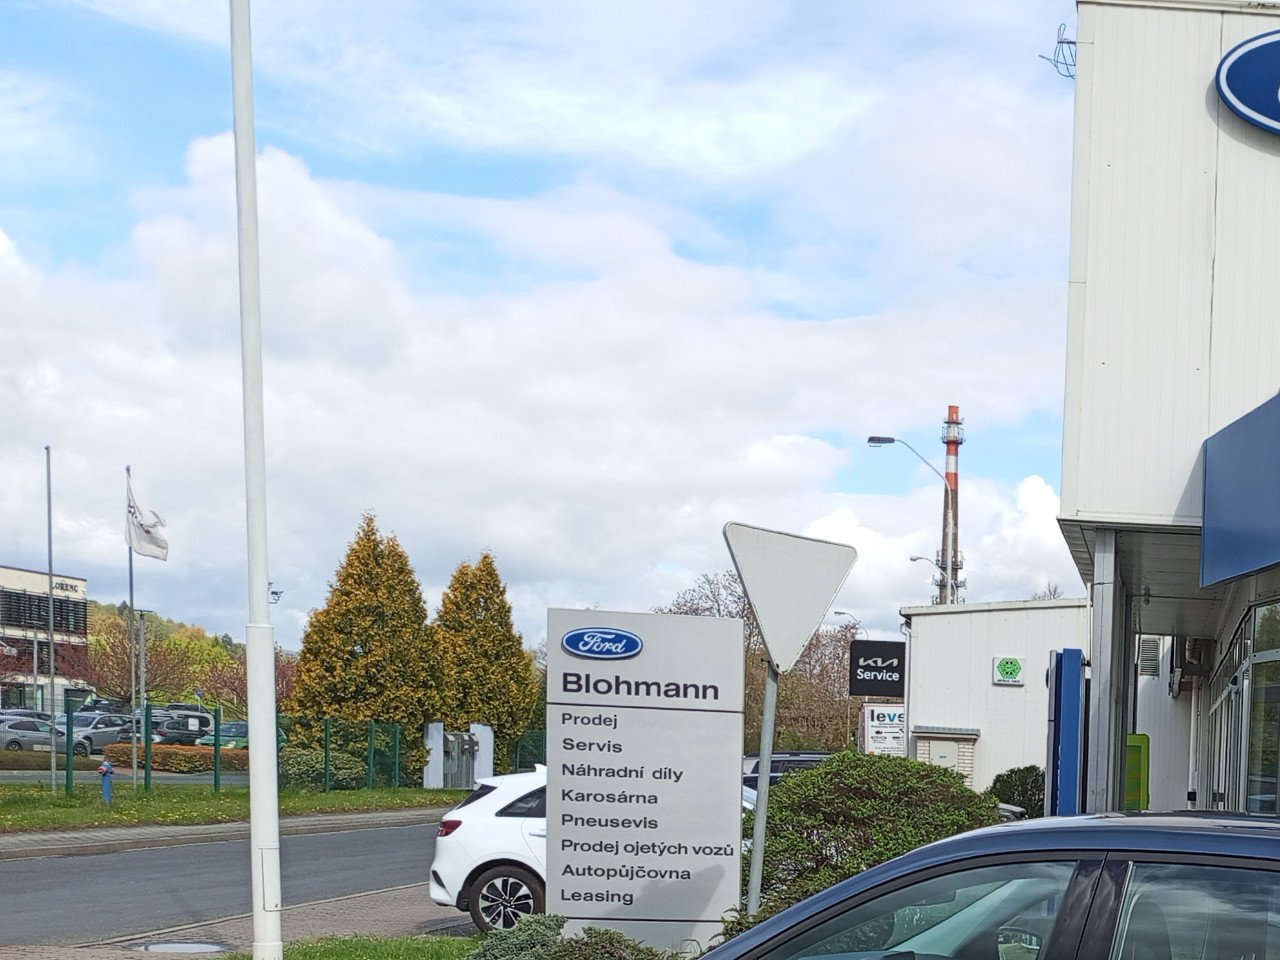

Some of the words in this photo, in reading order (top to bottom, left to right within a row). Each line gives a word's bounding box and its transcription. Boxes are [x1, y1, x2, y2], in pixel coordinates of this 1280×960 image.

[578, 632, 626, 653] Ford
[856, 668, 900, 681] Service
[562, 672, 719, 700] Blohmann
[561, 712, 618, 729] Prodej
[562, 738, 623, 753] Servis
[561, 763, 645, 779] Náhradní
[652, 767, 683, 783] díly
[561, 789, 658, 804] Karosárna
[561, 839, 619, 855] Prodej
[623, 841, 688, 857] ojetých
[692, 844, 734, 856] vozů
[562, 864, 691, 880] Autopůjčovna
[561, 889, 634, 905] Leasing
